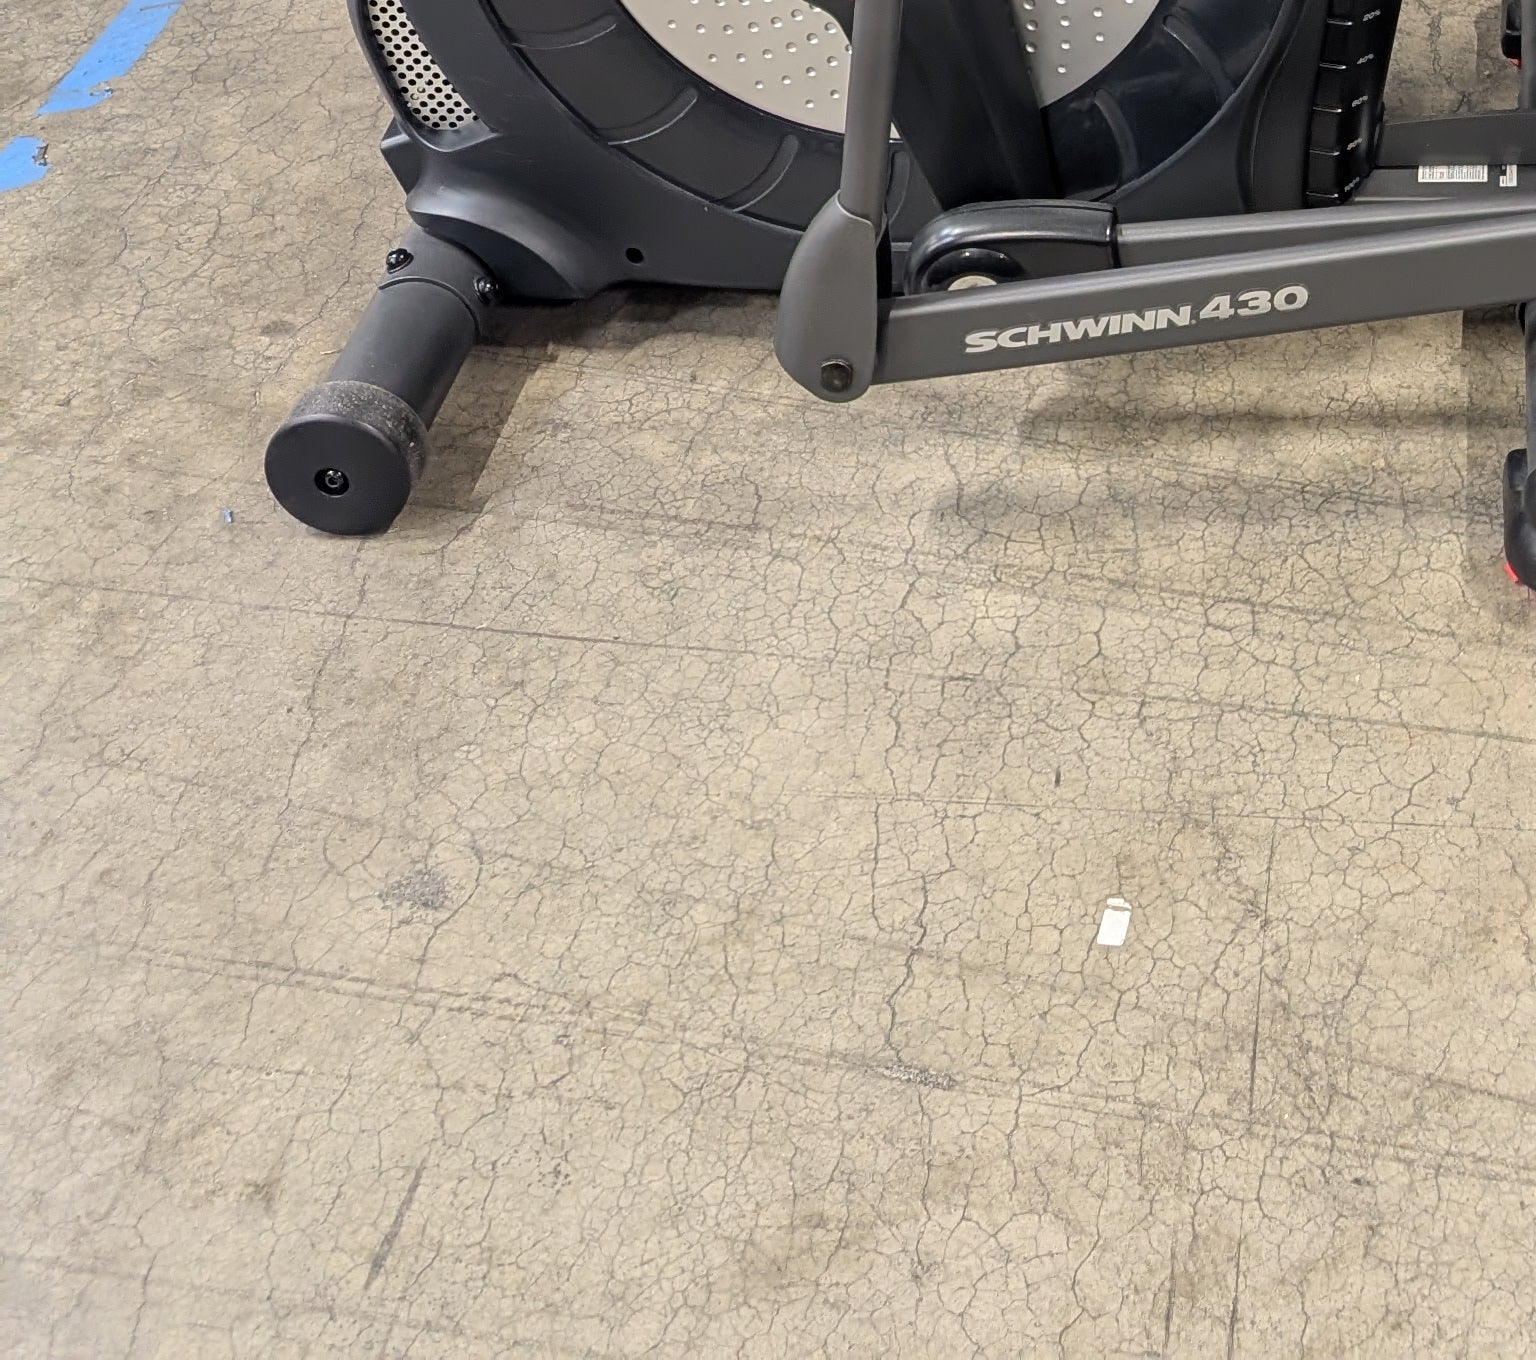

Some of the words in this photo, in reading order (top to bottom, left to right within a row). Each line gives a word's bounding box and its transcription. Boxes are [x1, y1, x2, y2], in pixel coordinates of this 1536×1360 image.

[1362, 9, 1381, 22] 20%
[964, 304, 1195, 354] SCHWINN
[1199, 285, 1309, 322] 430
